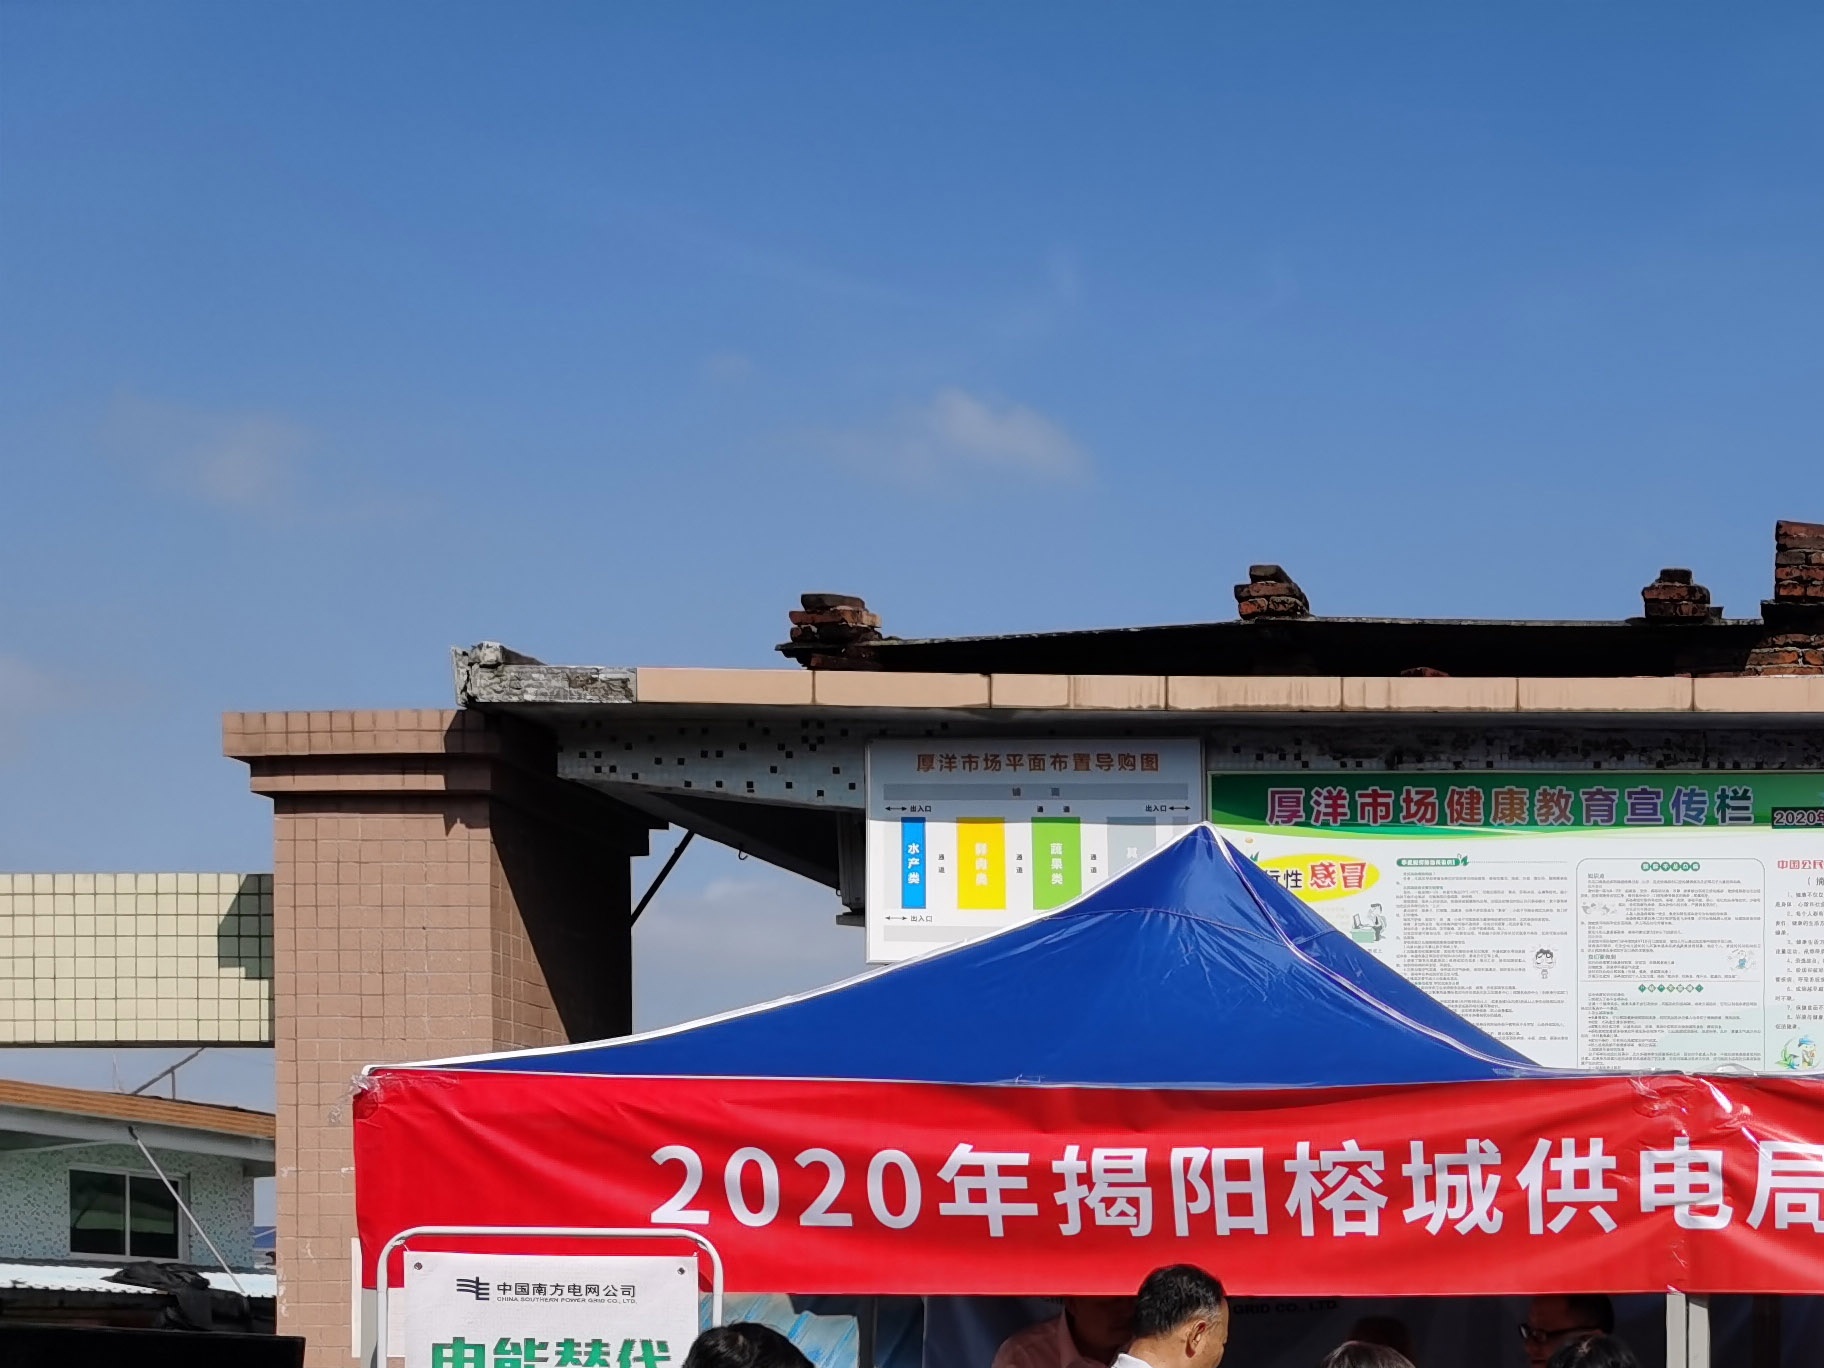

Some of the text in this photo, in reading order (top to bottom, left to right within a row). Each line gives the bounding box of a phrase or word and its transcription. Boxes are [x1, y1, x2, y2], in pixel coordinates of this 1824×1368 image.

[916, 752, 1160, 773] 厚洋市场平面布置导购图
[909, 805, 932, 813] 出入口
[1145, 805, 1168, 813] 出入口
[1265, 786, 1755, 827] 厚洋市场健康教育宣传栏
[908, 843, 920, 885] 水产类
[910, 914, 933, 922] 出入口
[496, 1281, 637, 1299] 中国南方电网公司
